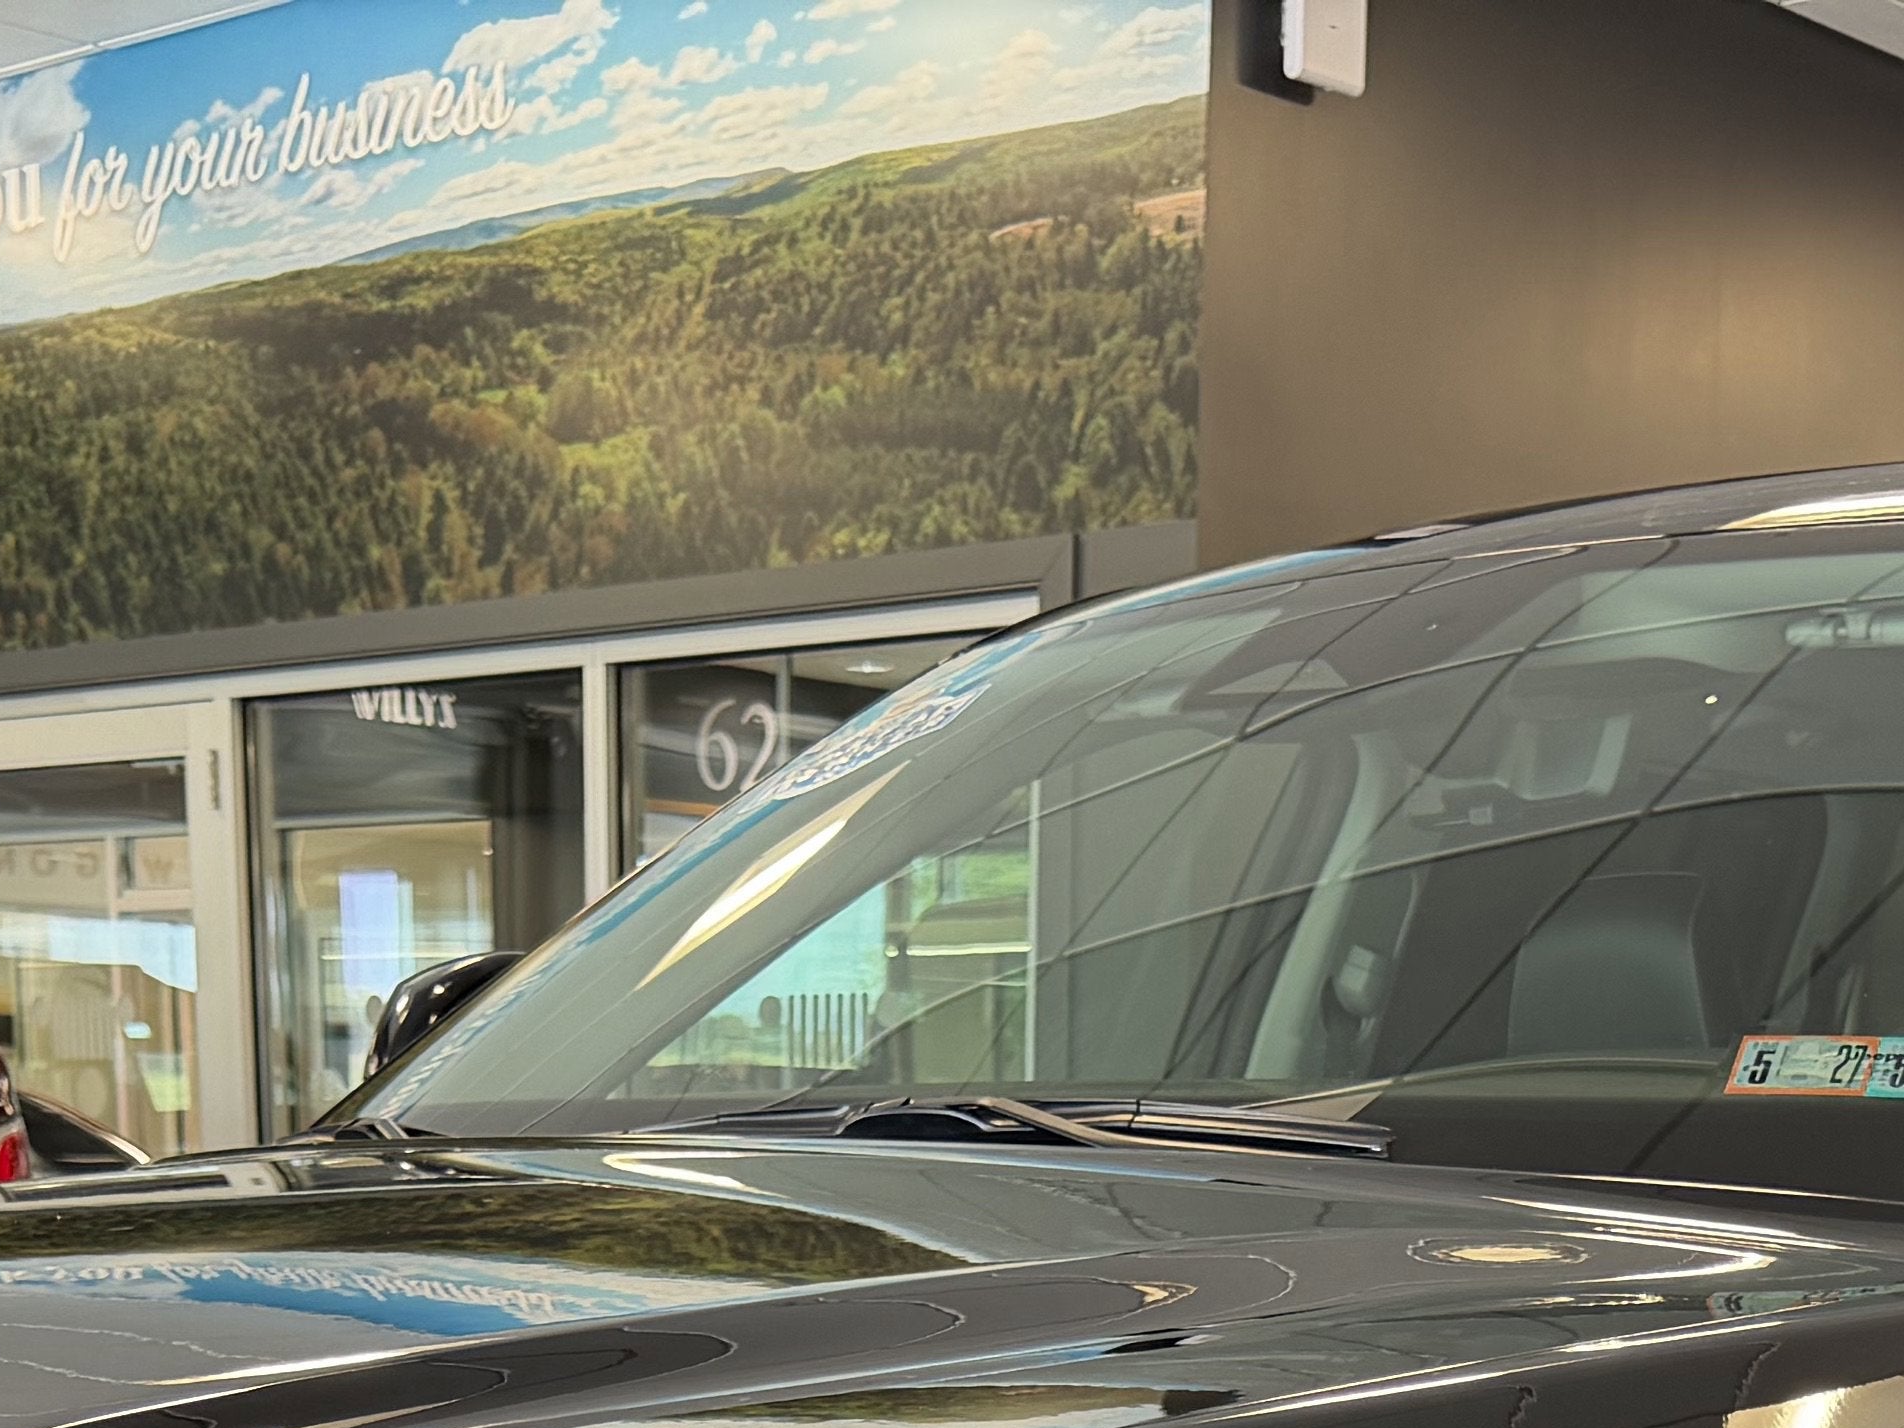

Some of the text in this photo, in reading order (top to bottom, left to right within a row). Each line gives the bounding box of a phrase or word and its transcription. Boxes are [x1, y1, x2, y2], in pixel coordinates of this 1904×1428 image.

[54, 131, 137, 262] for
[137, 123, 269, 254] your
[277, 61, 516, 174] business
[351, 688, 457, 729] WILLYS
[1748, 1045, 1869, 1088] 5 27
